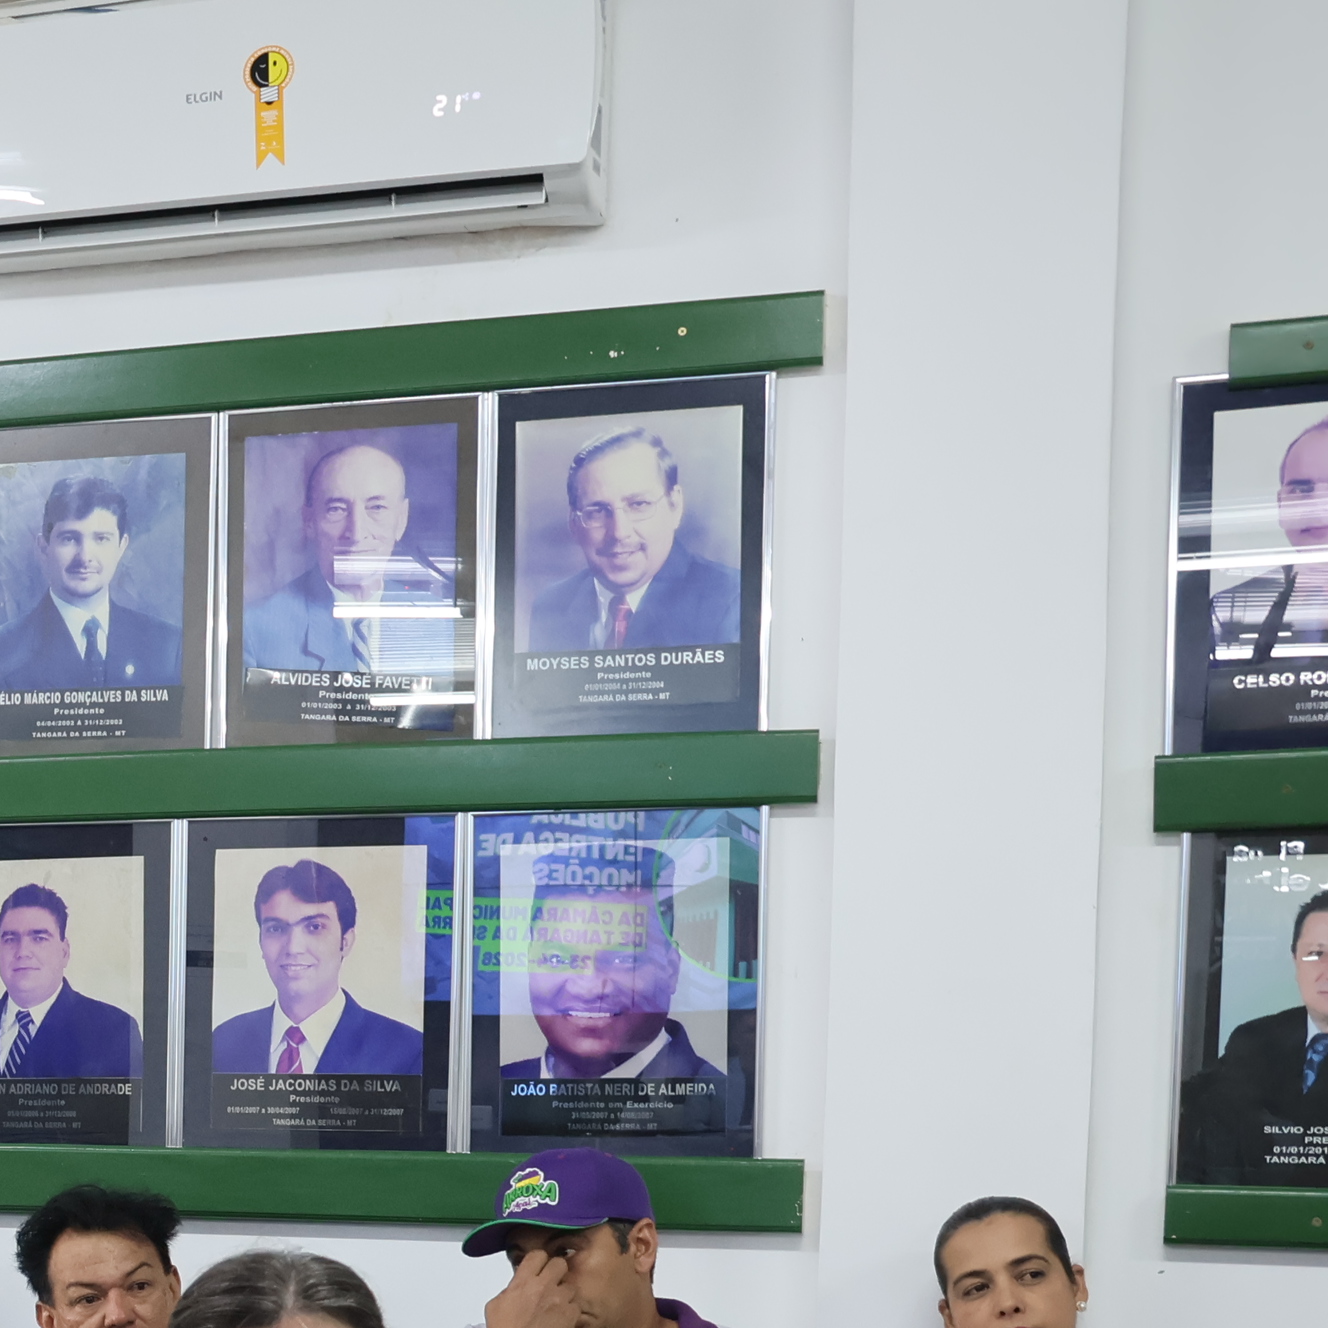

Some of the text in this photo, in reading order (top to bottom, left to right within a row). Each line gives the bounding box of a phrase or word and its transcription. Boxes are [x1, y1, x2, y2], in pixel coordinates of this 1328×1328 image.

[185, 90, 223, 105] ELGIN
[527, 648, 724, 671] MOYSES SANTOS DURÃES
[270, 672, 330, 687] ALVIDES
[333, 672, 371, 688] JOSÉ
[597, 671, 651, 680] Presidente
[1232, 671, 1328, 689] CELSO RO
[24, 690, 61, 704] MÁRCIO
[64, 689, 122, 706] GONÇALVES
[125, 690, 138, 702] DA
[141, 688, 169, 702] SILVA
[627, 692, 653, 701] SERRA
[301, 701, 342, 710] 01/01/2003
[53, 707, 105, 715] Presidente
[36, 719, 75, 727] 04/04/2002
[300, 713, 378, 723] TANGARÁ DA SERRA
[32, 730, 67, 738] TANGARÁ
[69, 730, 80, 738] DA
[115, 729, 126, 737] MT
[9, 1083, 59, 1095] ADRIANO
[61, 1083, 76, 1095] DE
[79, 1083, 132, 1095] ANDRADE
[230, 1076, 402, 1092] JOSÉ JACONIAS DA SILVA
[510, 1082, 717, 1096] JOÃO BATISTA NERI DE ALMEIDA
[18, 1098, 66, 1107] Presidente
[289, 1095, 341, 1104] Presidente
[552, 1100, 605, 1109] Presidente
[227, 1106, 300, 1114] 01/01/2007 30/04/2007
[272, 1116, 341, 1126] TANGARÁ DA SERRA
[1263, 1125, 1304, 1135] SILVIO
[1264, 1155, 1327, 1165] TANGARÁ
